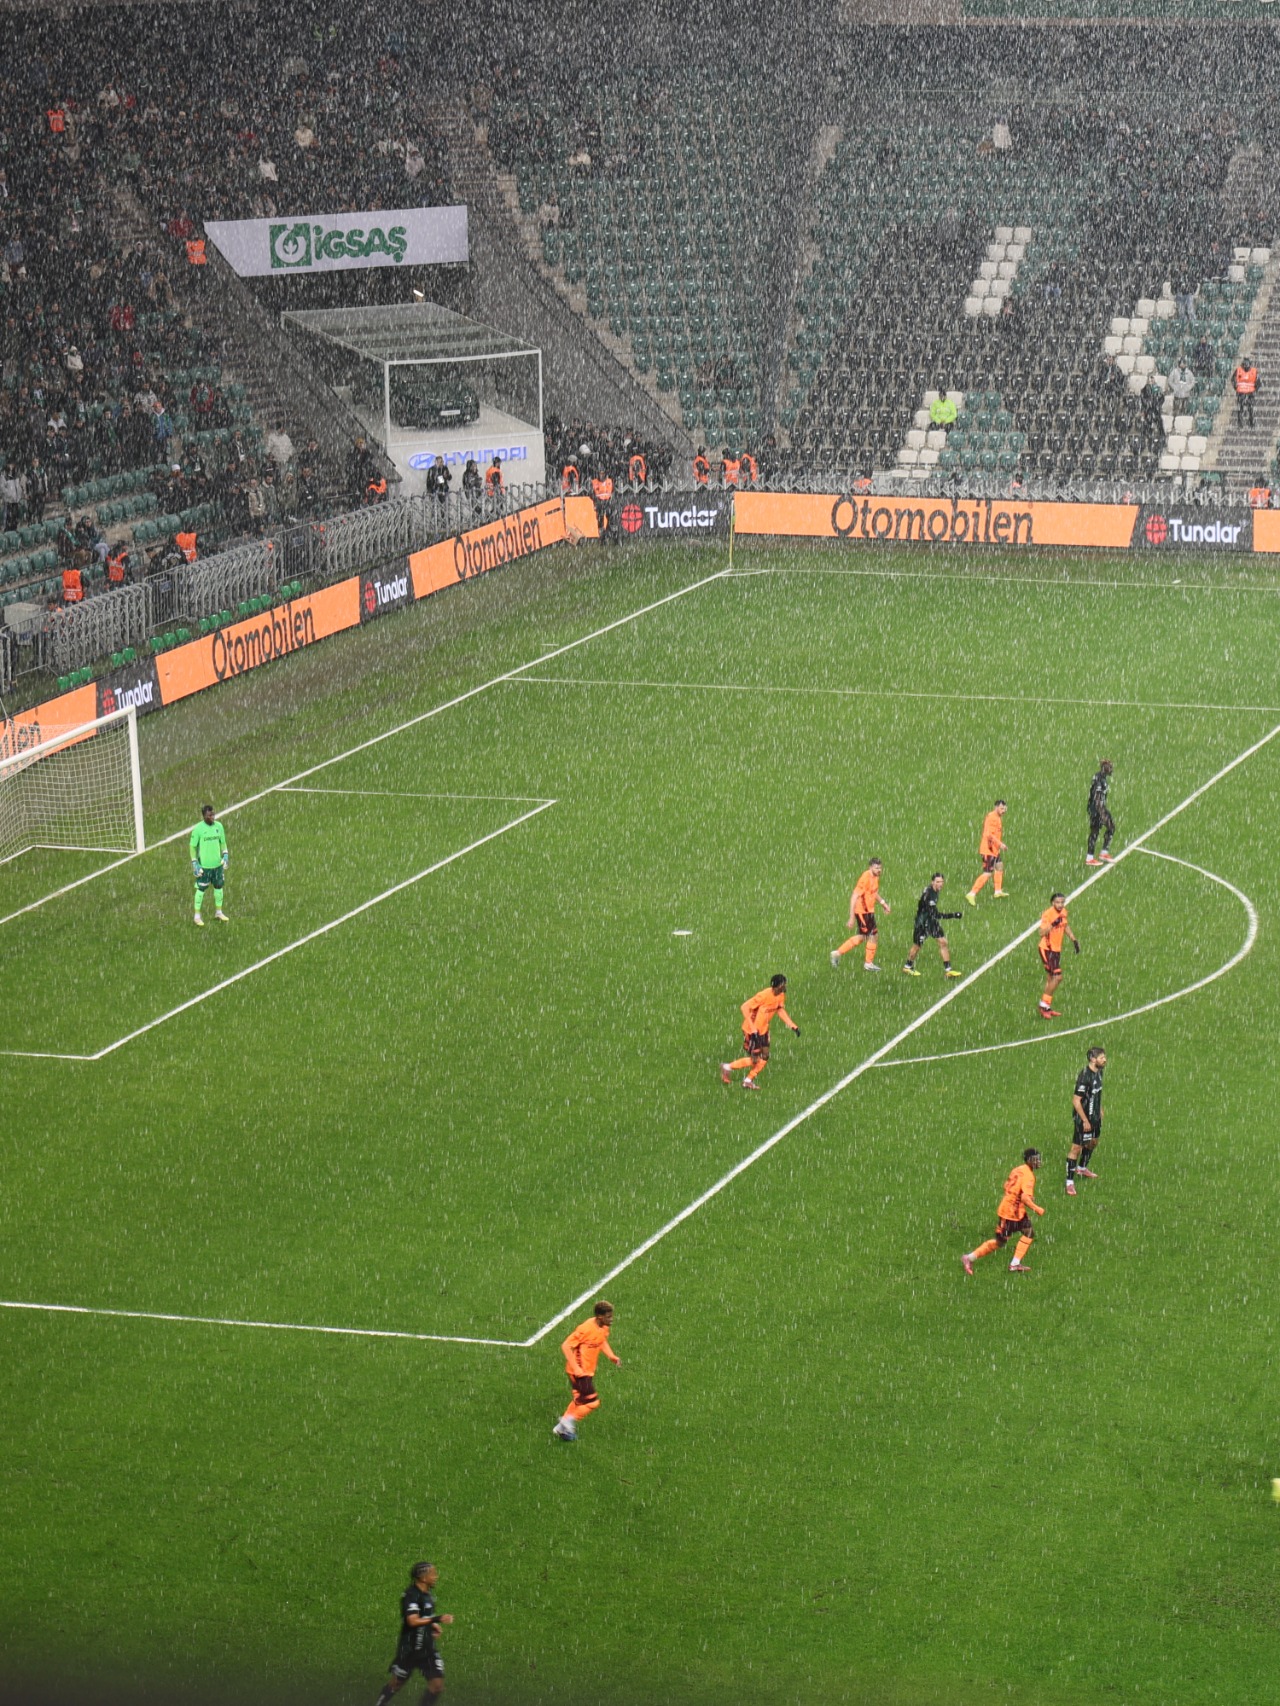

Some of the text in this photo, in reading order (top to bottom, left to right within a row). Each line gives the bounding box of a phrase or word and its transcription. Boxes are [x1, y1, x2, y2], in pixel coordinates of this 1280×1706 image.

[645, 506, 718, 529] Tunalar
[831, 494, 1034, 545] Otomobilen
[1168, 518, 1242, 544] Tunalar
[454, 512, 543, 579] Otomobilen
[374, 575, 408, 606] Tunalar
[212, 601, 316, 680] Otomobilen
[114, 680, 153, 710] Tunalar
